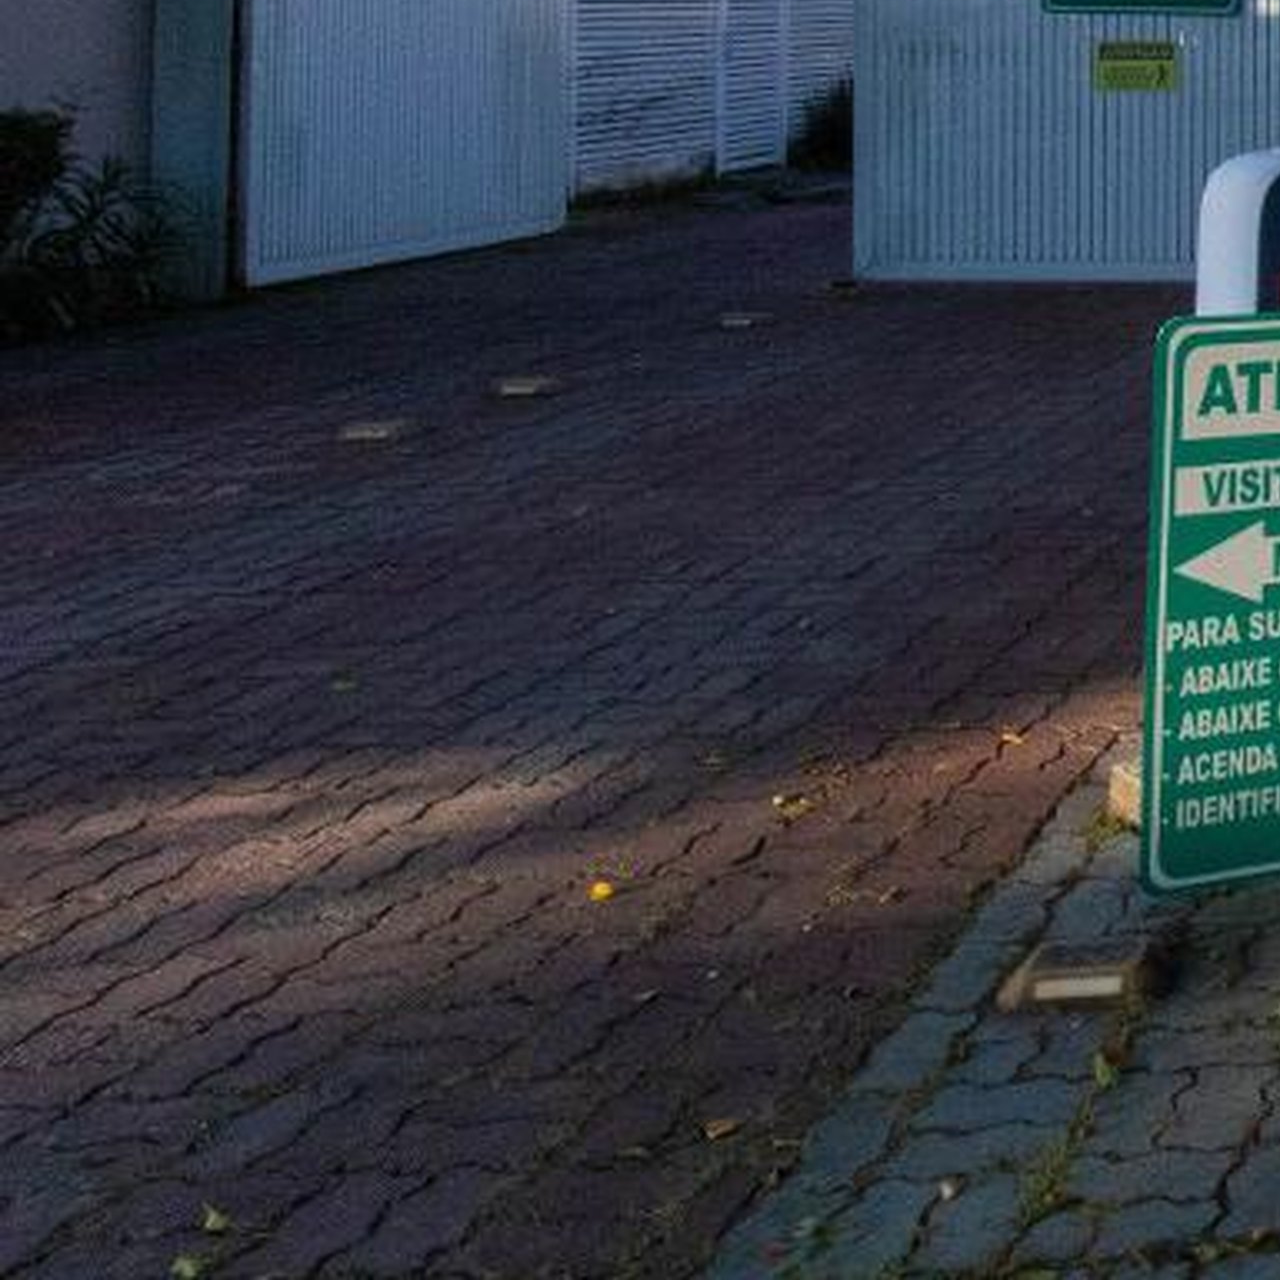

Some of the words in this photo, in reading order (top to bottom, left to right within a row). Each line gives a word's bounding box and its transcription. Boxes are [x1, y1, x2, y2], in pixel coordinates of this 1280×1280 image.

[1166, 613, 1241, 652] PARA
[1179, 657, 1272, 698] ABAIXE
[1178, 699, 1272, 741] ABAIXE
[1177, 741, 1279, 785] ACENDA
